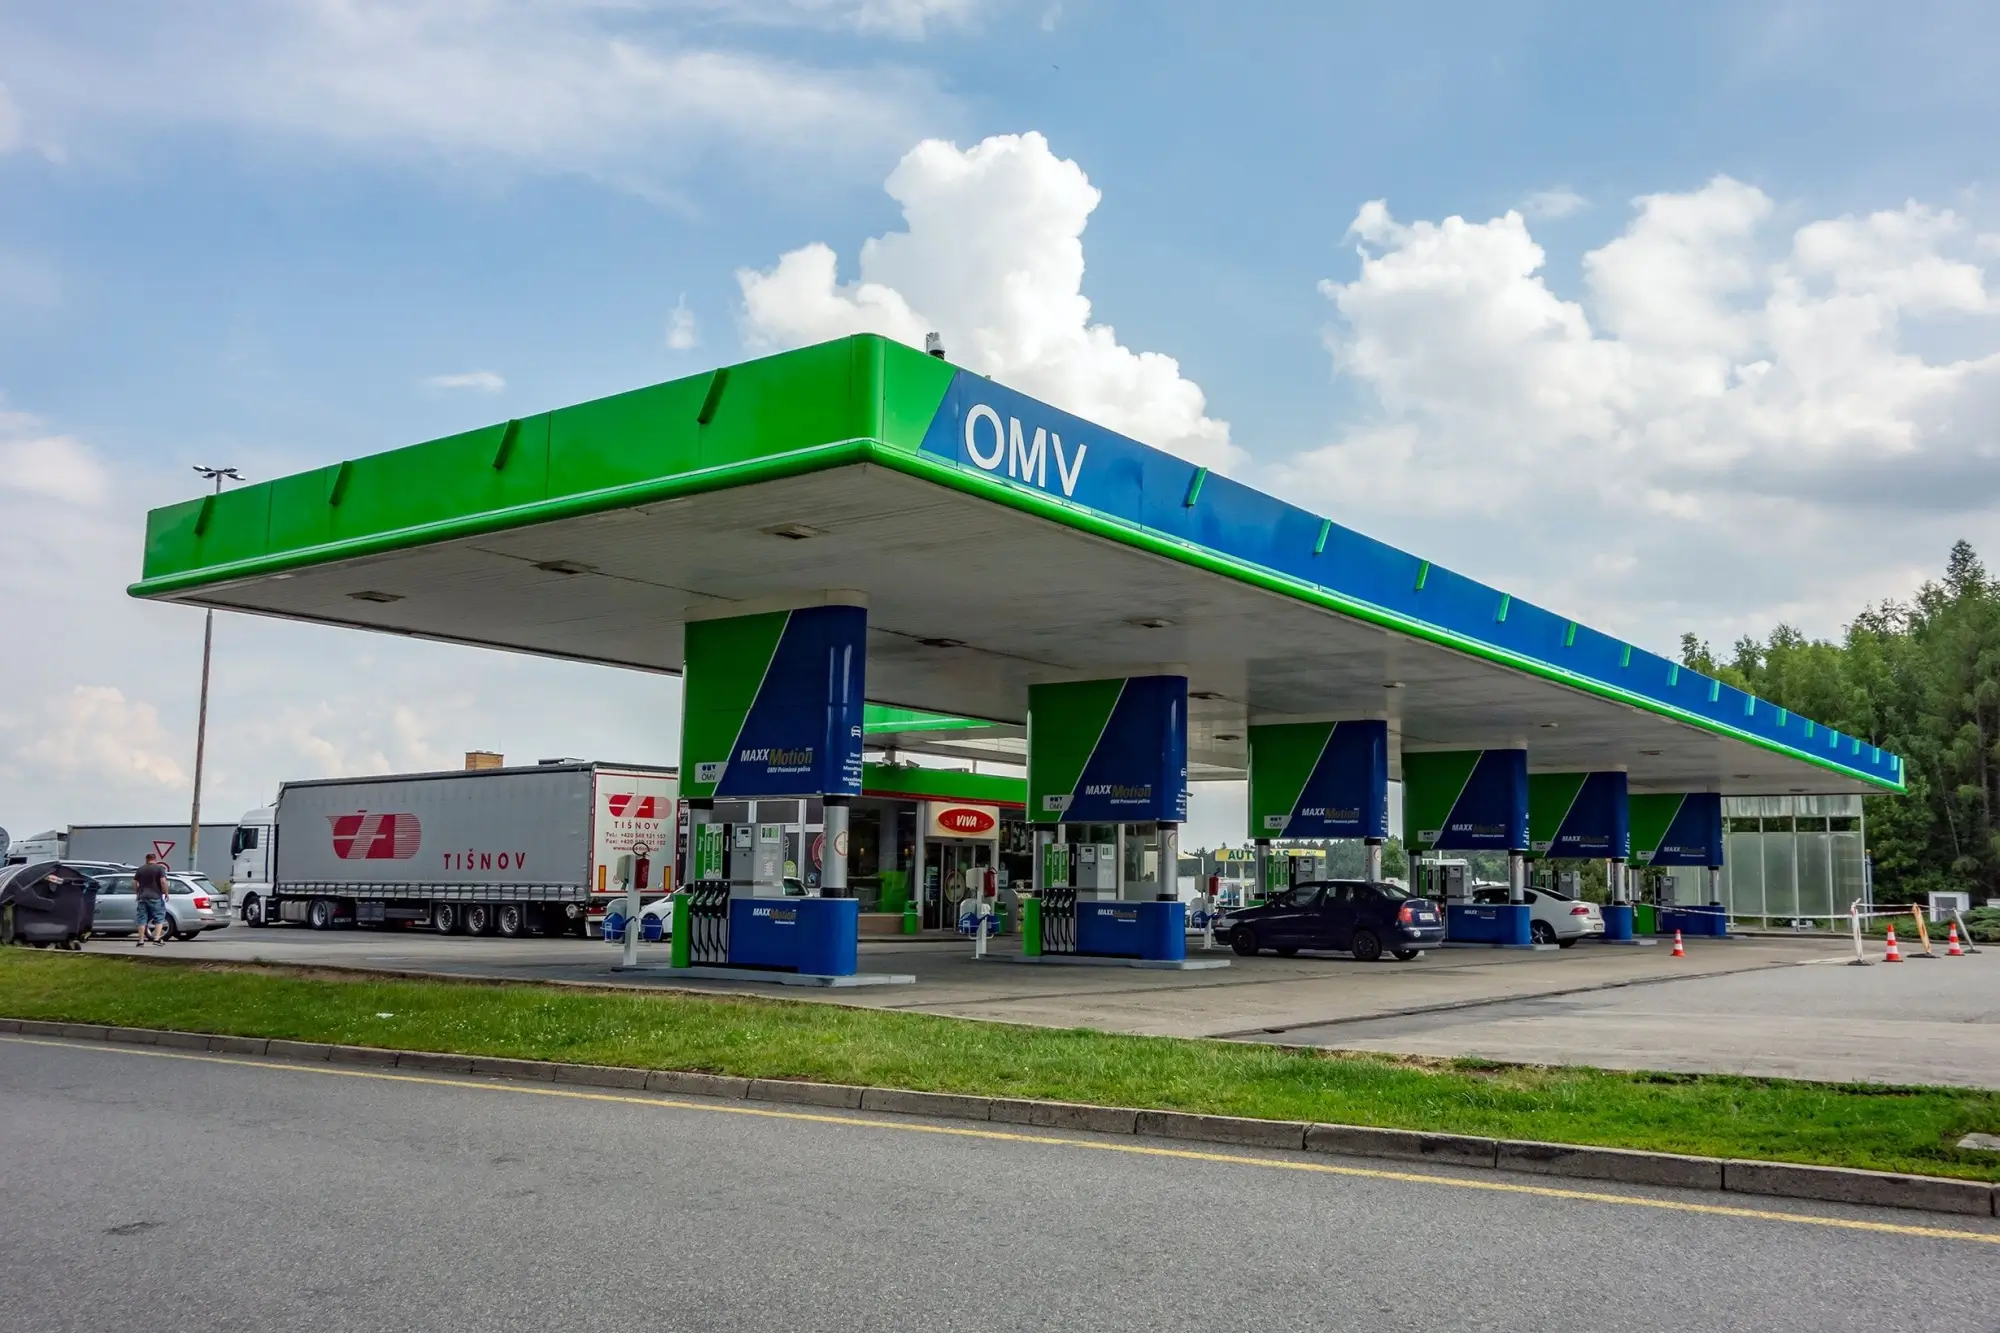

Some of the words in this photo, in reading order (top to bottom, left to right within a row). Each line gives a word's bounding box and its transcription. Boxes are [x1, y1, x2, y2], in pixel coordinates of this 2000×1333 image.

[965, 403, 1087, 497] OMV
[614, 820, 659, 830] TIŠNOV
[956, 815, 977, 827] VIVA
[444, 848, 525, 870] TIŠNOV
